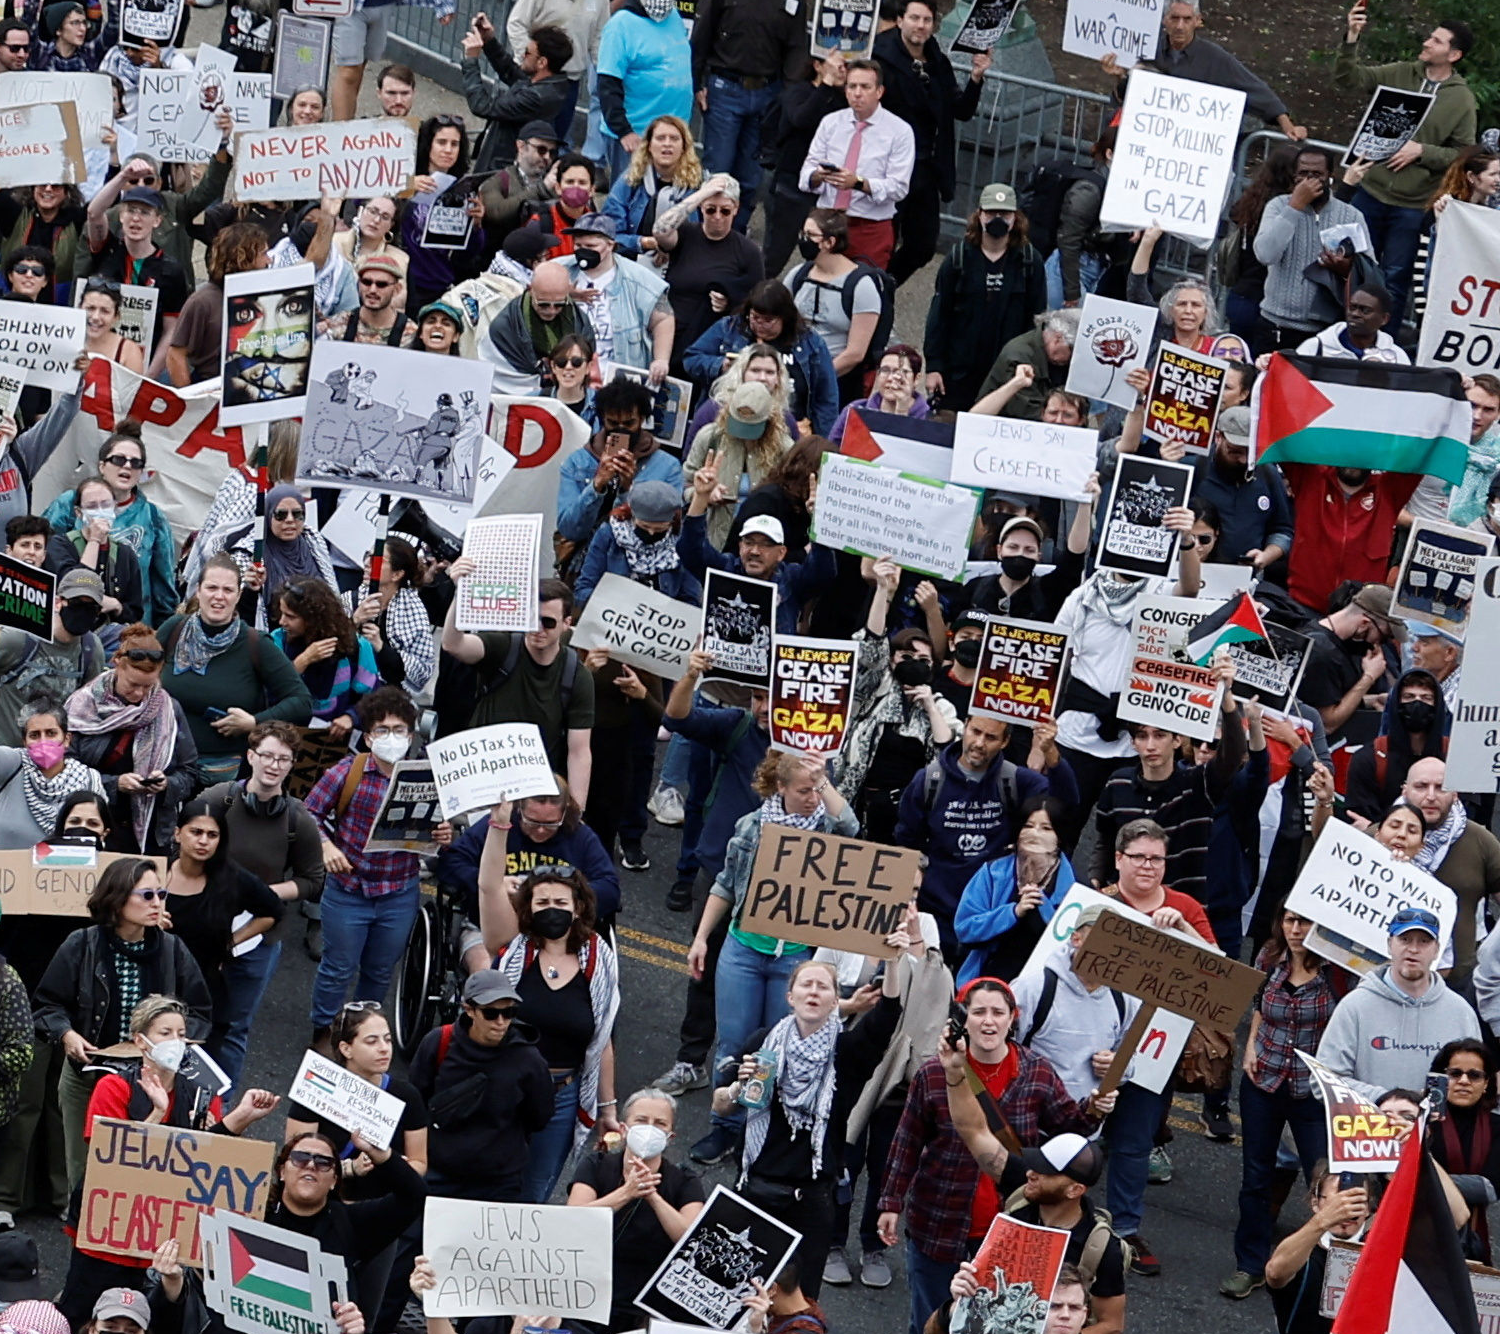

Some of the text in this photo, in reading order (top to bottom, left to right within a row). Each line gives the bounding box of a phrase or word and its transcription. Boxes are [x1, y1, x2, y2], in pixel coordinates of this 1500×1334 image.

[1108, 12, 1118, 23] A
[1073, 15, 1151, 60] WAR CRIME
[250, 130, 402, 159] NEVER AGAIN
[244, 156, 409, 191] NOT TO ANYONE
[1160, 362, 1220, 394] CEASE
[1176, 357, 1202, 371] JEWS
[1202, 365, 1222, 377] SAY
[1160, 382, 1209, 409] FIRE
[1176, 401, 1189, 410] IN
[1150, 400, 1210, 434] GAZA
[440, 750, 457, 766] No
[460, 743, 478, 758] US
[480, 739, 504, 754] Tax
[519, 737, 536, 749] for
[437, 752, 546, 787] Israeli Apartheid
